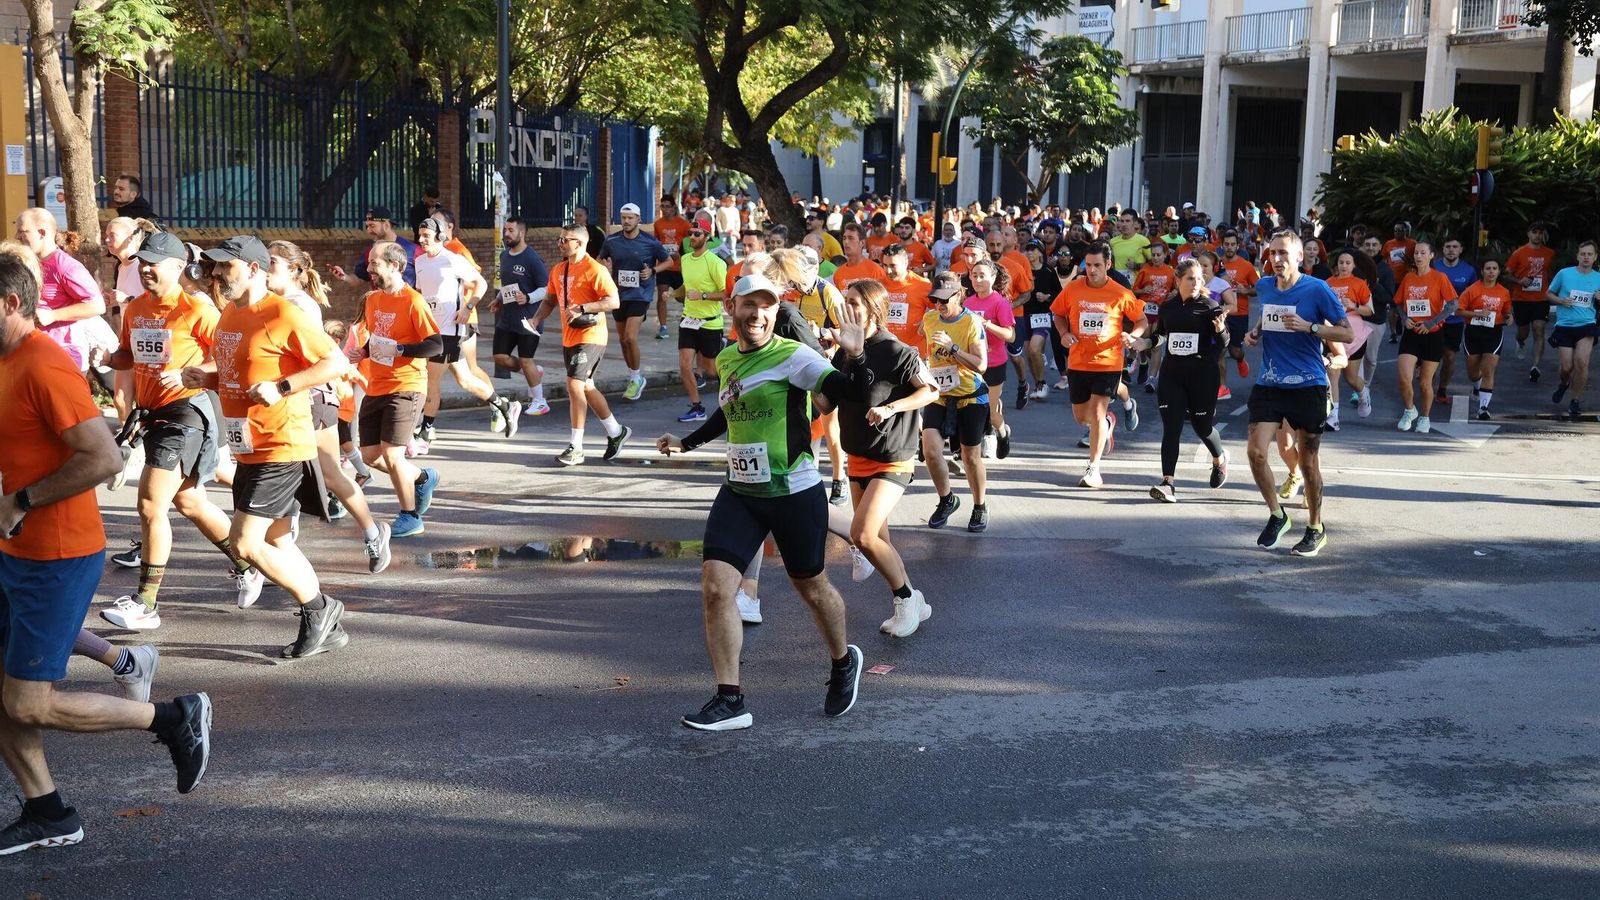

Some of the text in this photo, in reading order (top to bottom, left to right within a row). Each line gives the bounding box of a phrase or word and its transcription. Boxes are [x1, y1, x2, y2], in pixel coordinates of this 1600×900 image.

[621, 275, 636, 283] 360
[1573, 295, 1589, 303] 798
[1410, 304, 1426, 312] 856
[1083, 320, 1103, 328] 684
[136, 341, 164, 353] 556
[1172, 341, 1192, 349] 903
[227, 431, 242, 443] 36
[731, 457, 759, 472] 501
